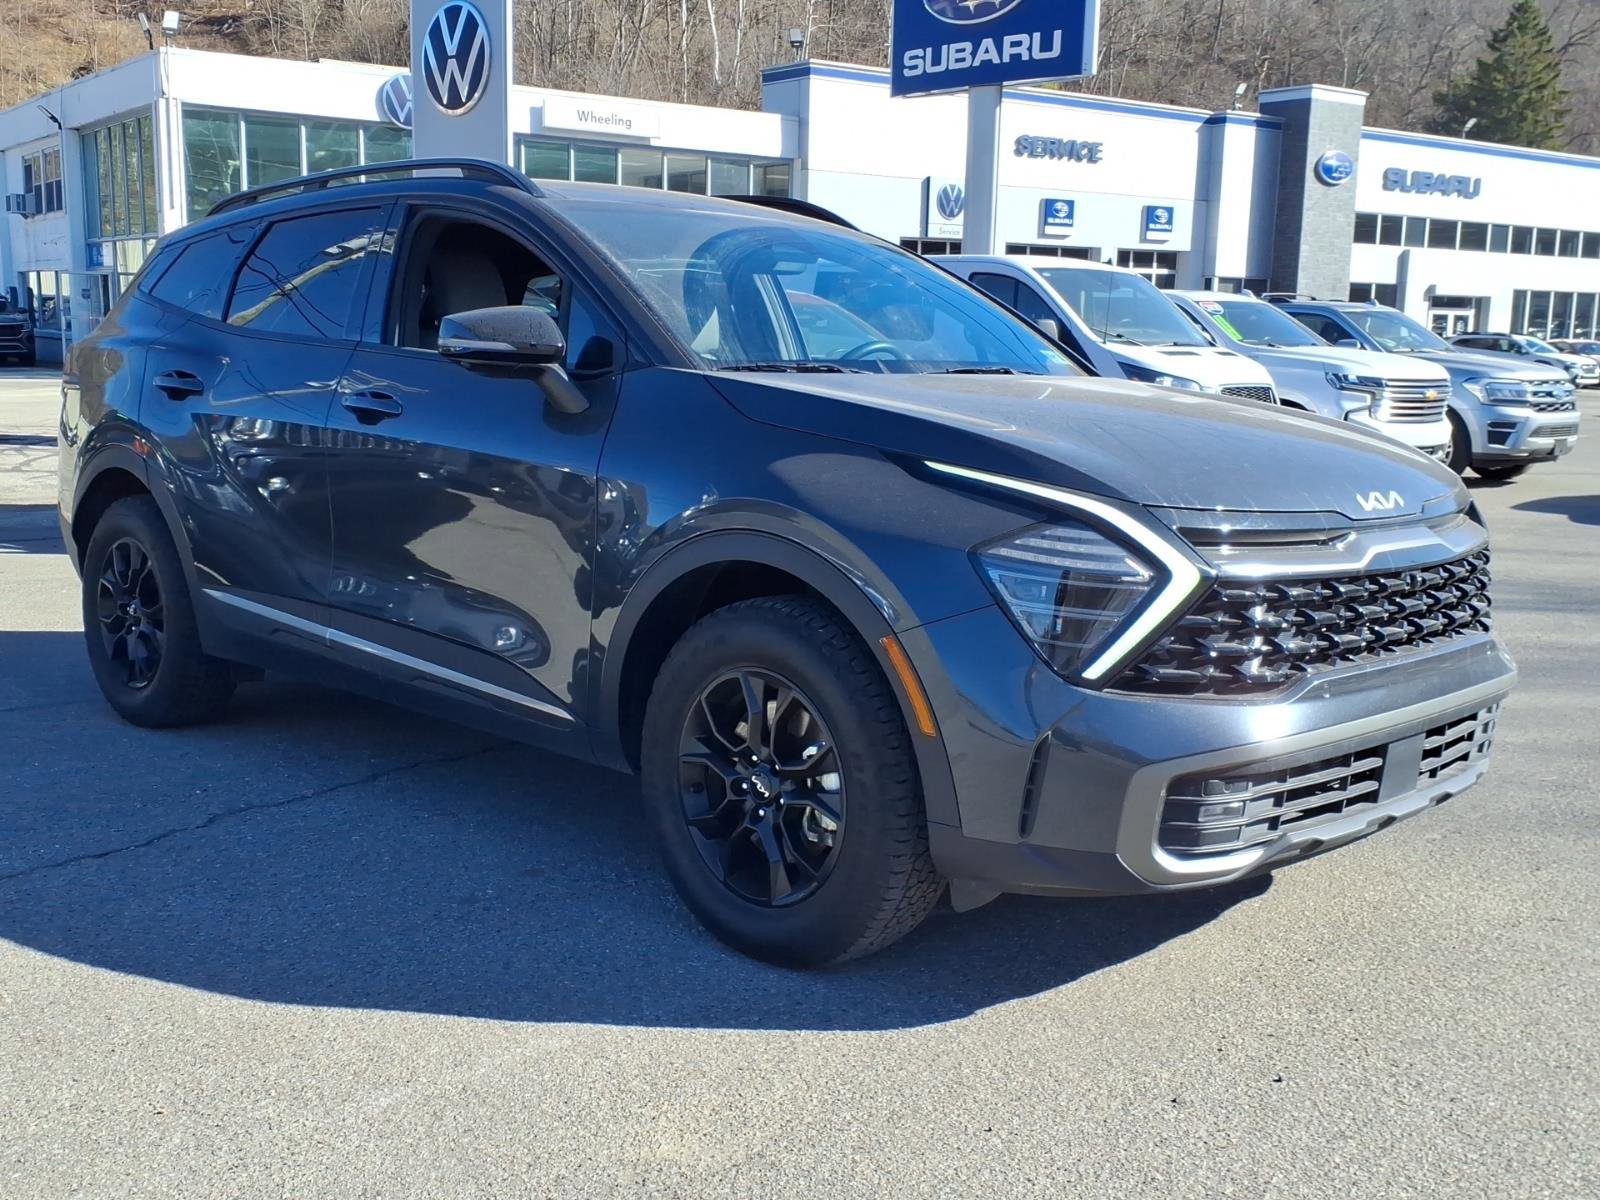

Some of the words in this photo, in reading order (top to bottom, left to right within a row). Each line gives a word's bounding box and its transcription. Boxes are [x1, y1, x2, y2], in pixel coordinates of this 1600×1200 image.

[902, 29, 1063, 77] SUBARU
[577, 109, 632, 130] Wheeling
[1014, 134, 1103, 164] SERVICE
[1382, 167, 1482, 200] SUBARU
[1047, 217, 1073, 225] SUBARU
